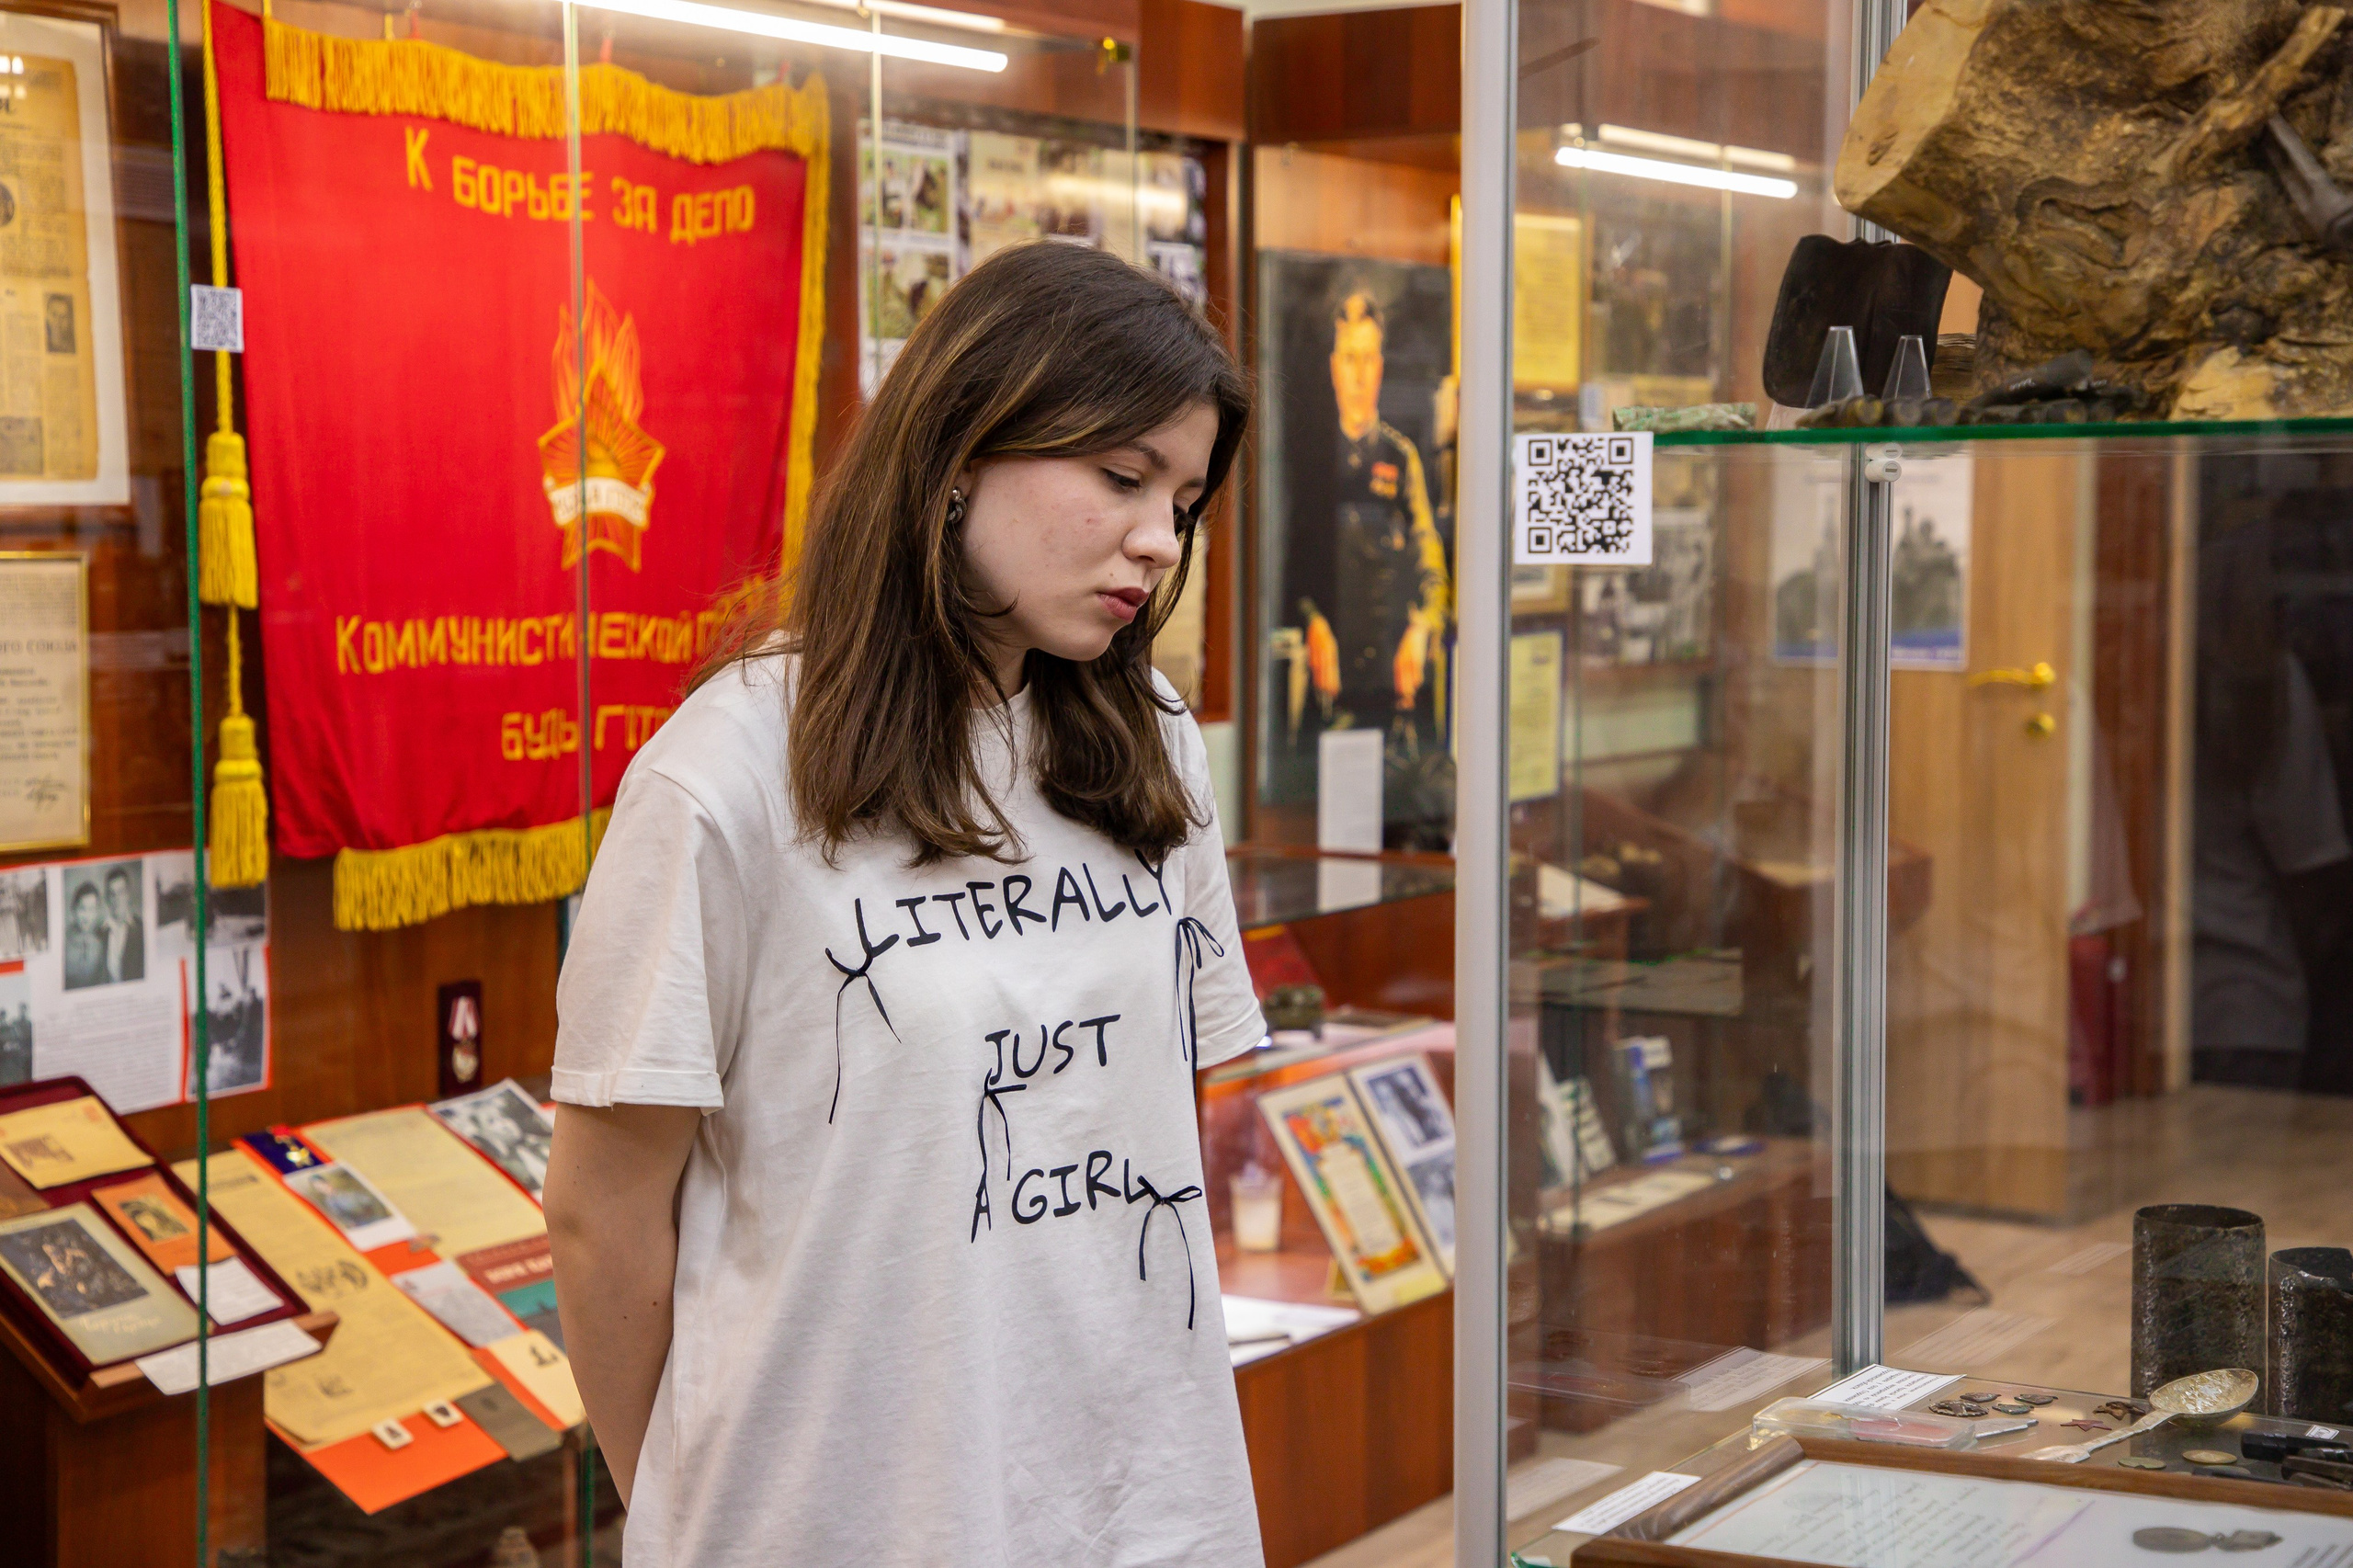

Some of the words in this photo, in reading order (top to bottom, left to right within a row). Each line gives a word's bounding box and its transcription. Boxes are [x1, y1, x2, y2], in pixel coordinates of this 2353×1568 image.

[404, 126, 434, 191] К
[452, 154, 596, 222] БОРЬБЕ
[611, 176, 658, 234] ЗА
[670, 185, 756, 246] ДЕЛО
[854, 848, 1173, 958] LITERALLY
[984, 1014, 1122, 1086] JUST
[971, 1173, 993, 1244] A
[1011, 1149, 1151, 1225] GIRL
